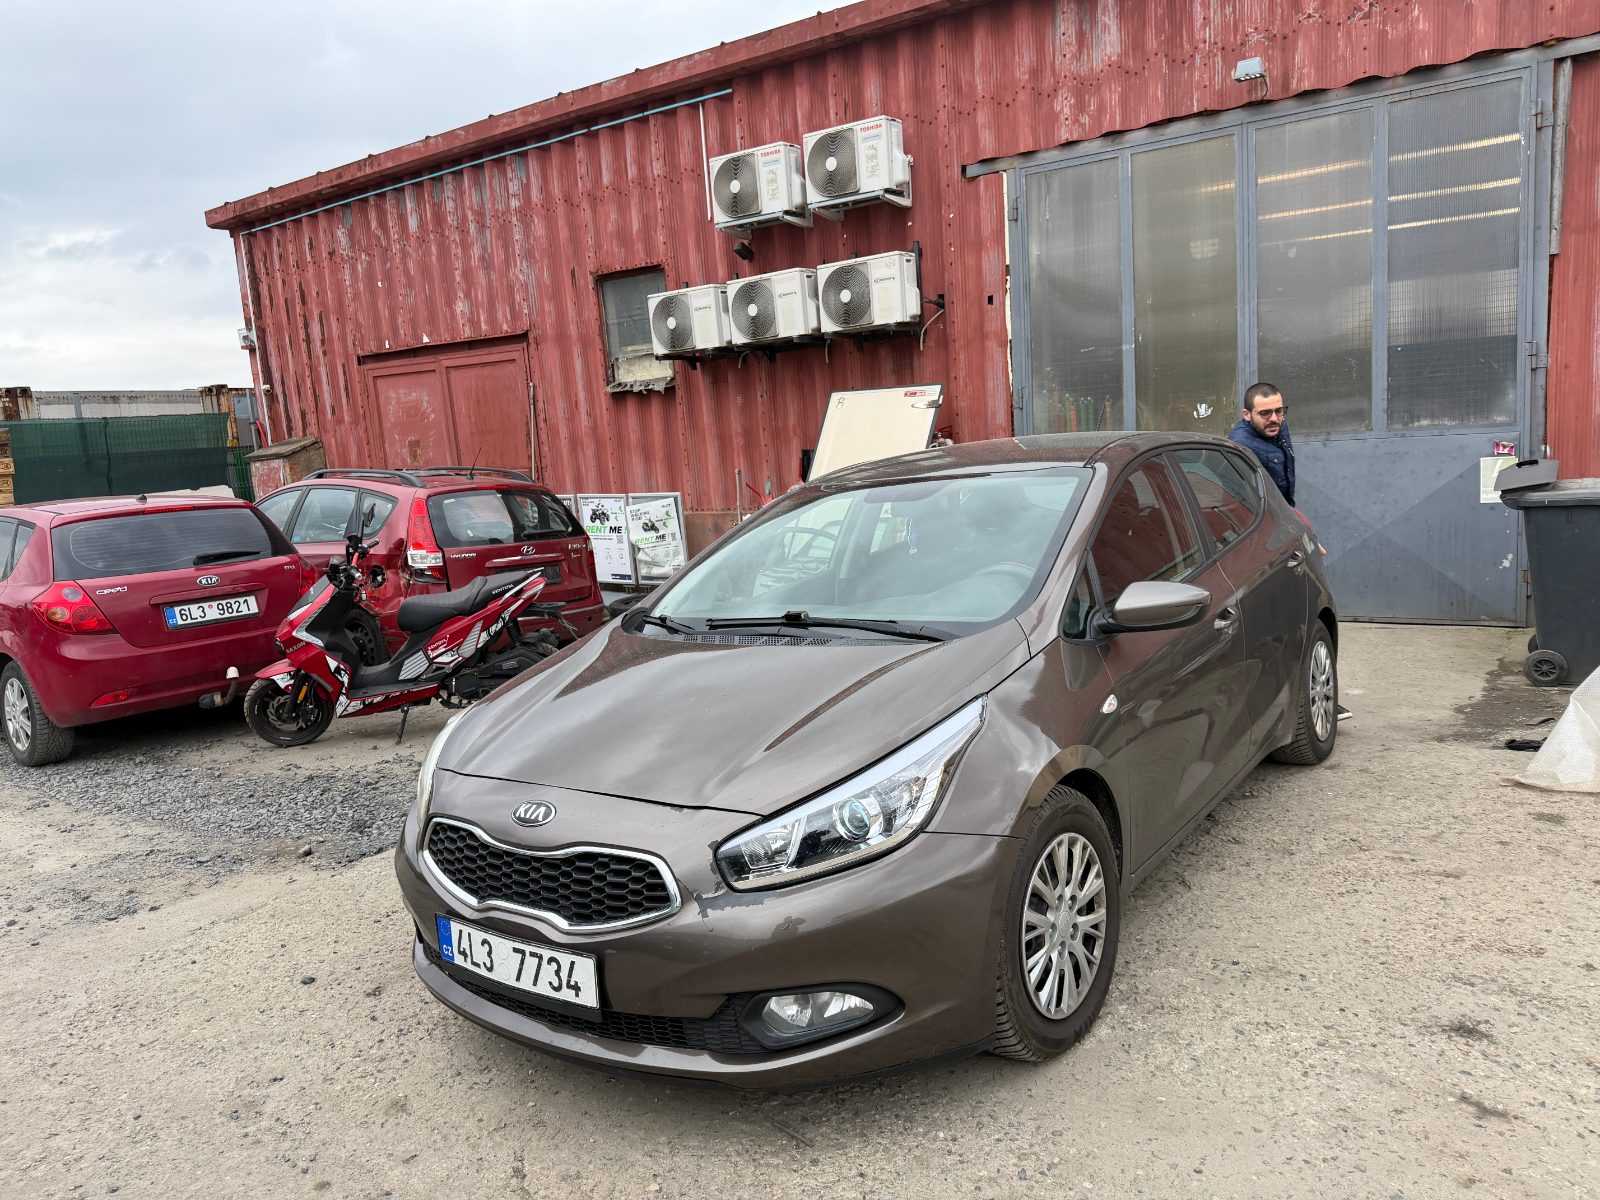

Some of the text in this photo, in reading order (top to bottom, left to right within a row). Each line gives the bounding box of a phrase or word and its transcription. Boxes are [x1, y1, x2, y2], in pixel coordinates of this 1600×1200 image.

[859, 123, 882, 133] TOSHIBA
[760, 149, 781, 158] TOSHIBA
[585, 525, 622, 534] RENT ME
[635, 536, 655, 544] RENT
[201, 576, 217, 585] KIA
[179, 598, 251, 622] 6L3 9821
[286, 641, 306, 654] SAXON
[515, 803, 547, 822] KIA
[442, 944, 453, 957] CZ
[457, 928, 582, 998] 4L3 7734
